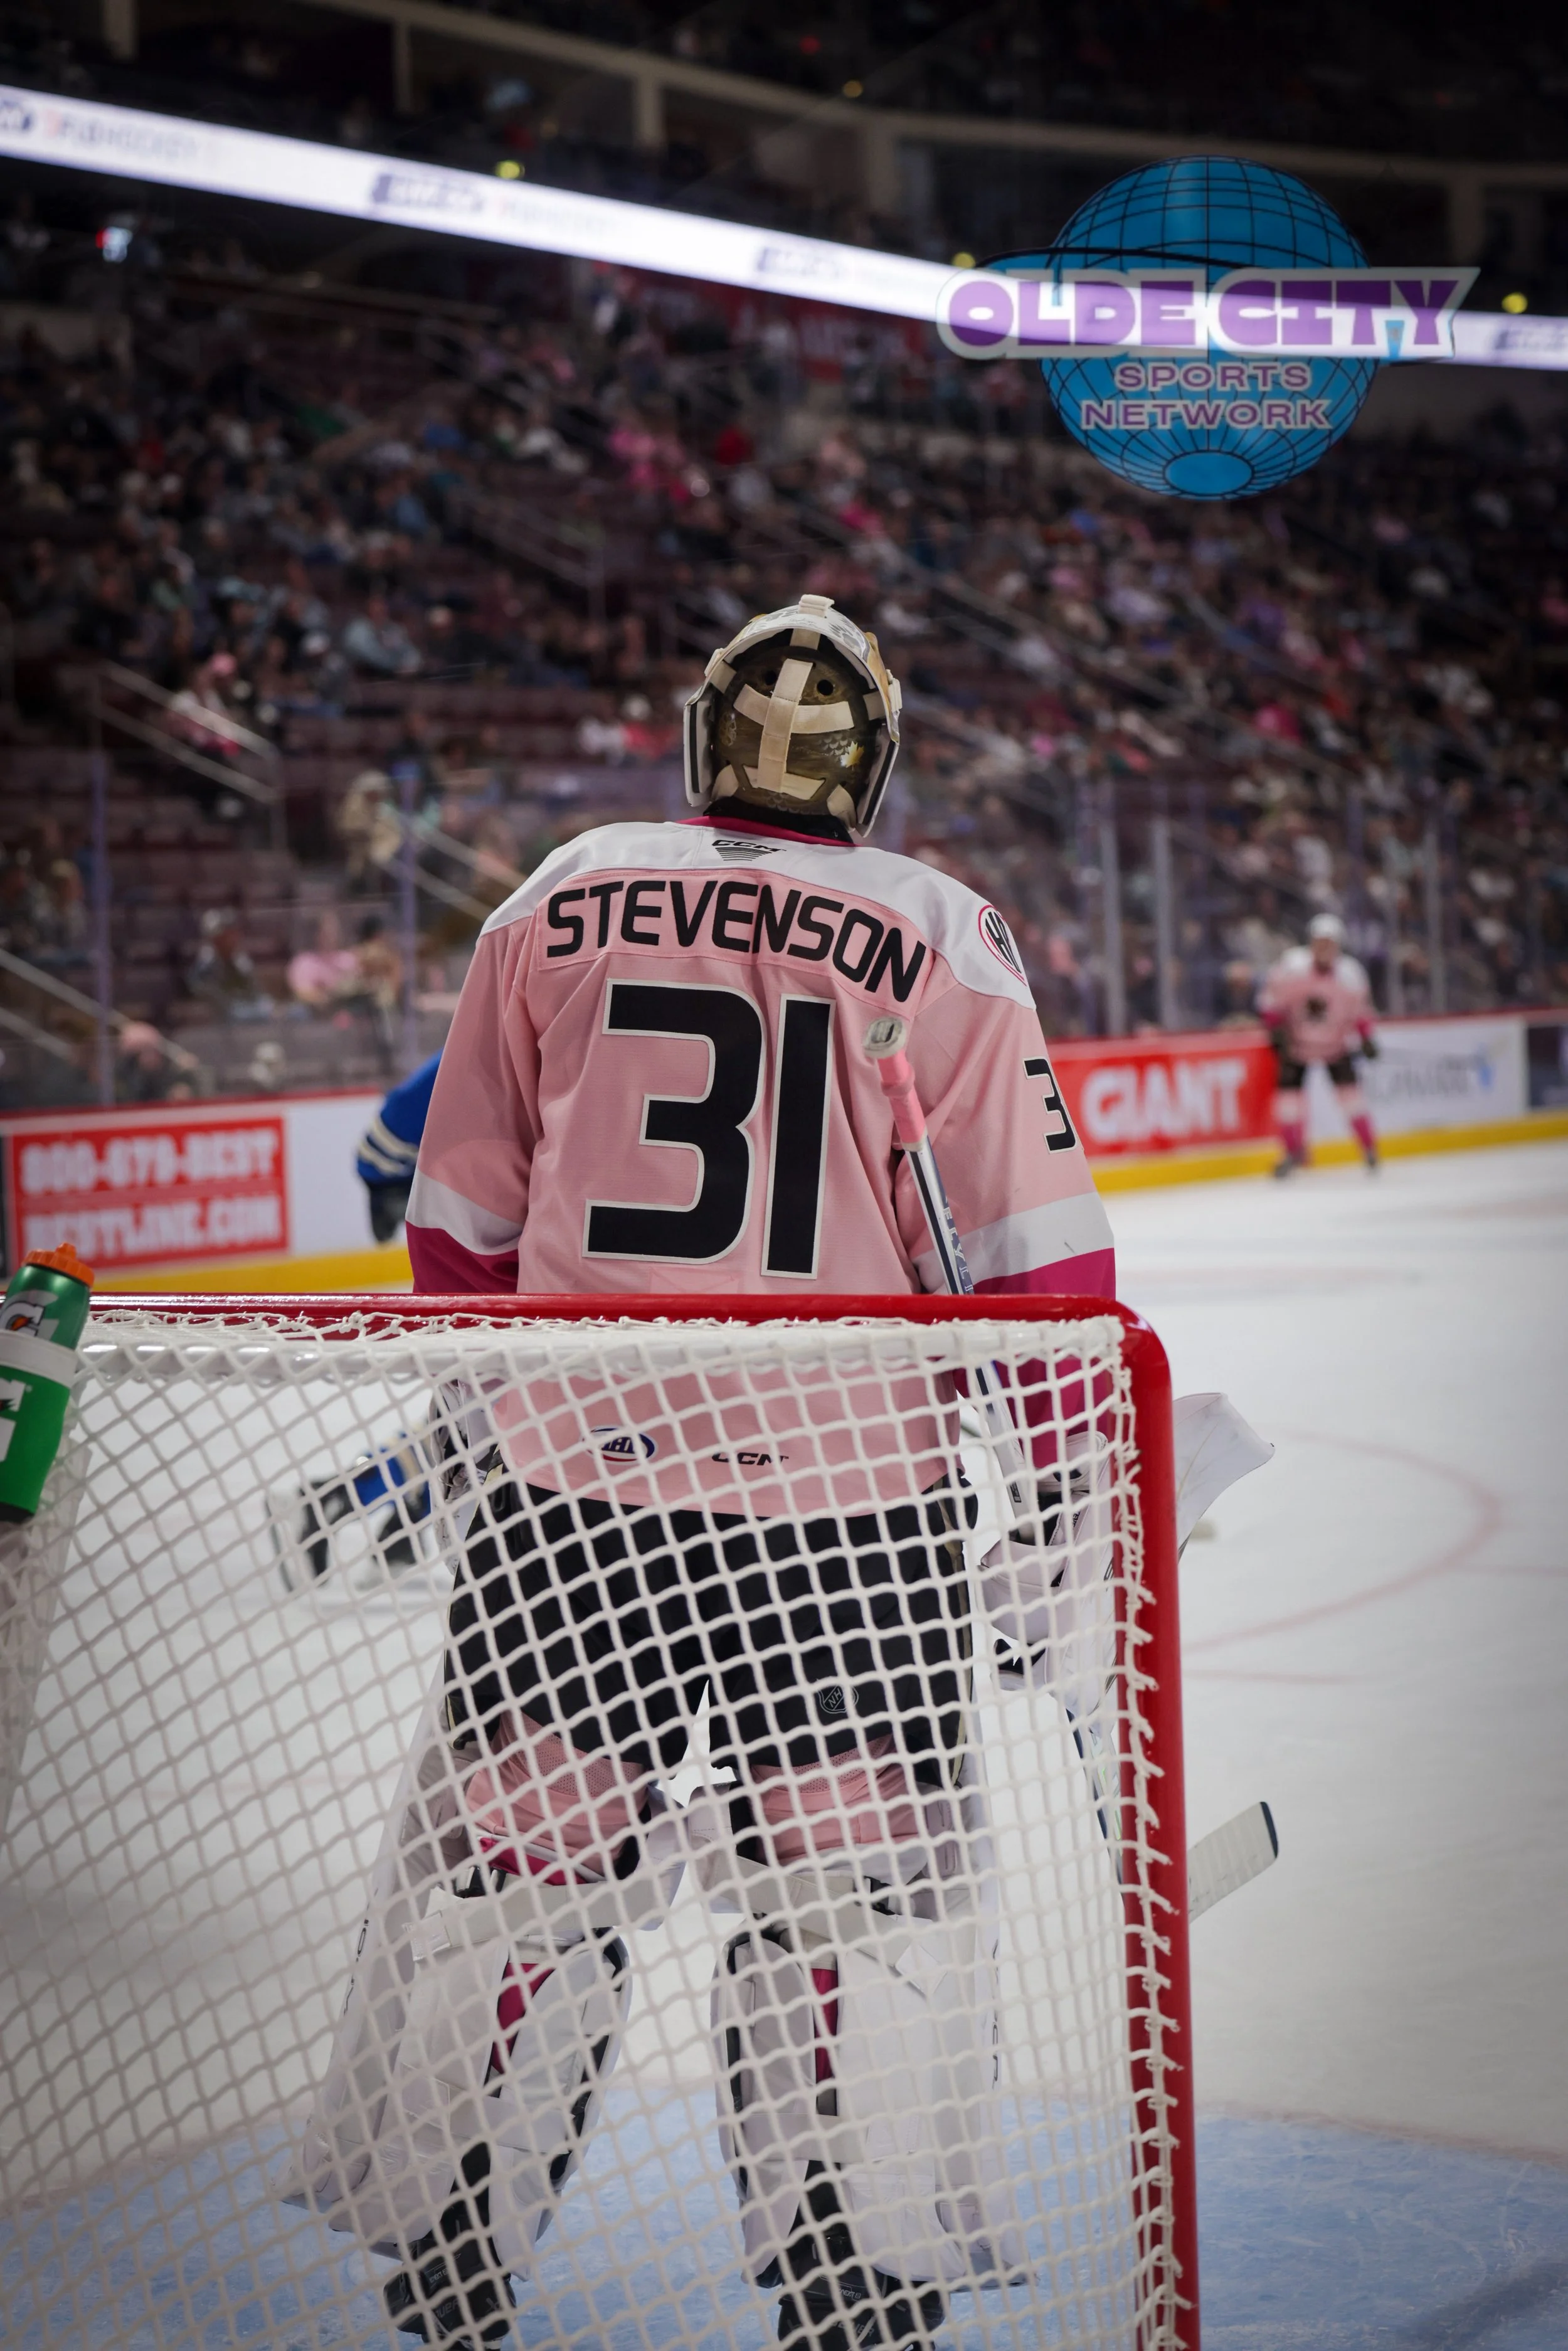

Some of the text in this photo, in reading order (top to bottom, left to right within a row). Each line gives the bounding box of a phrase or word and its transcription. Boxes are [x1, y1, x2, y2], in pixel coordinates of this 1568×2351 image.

[546, 880, 926, 1003] STEVENSON
[583, 978, 837, 1278] 31
[1081, 1059, 1244, 1144] GIANT
